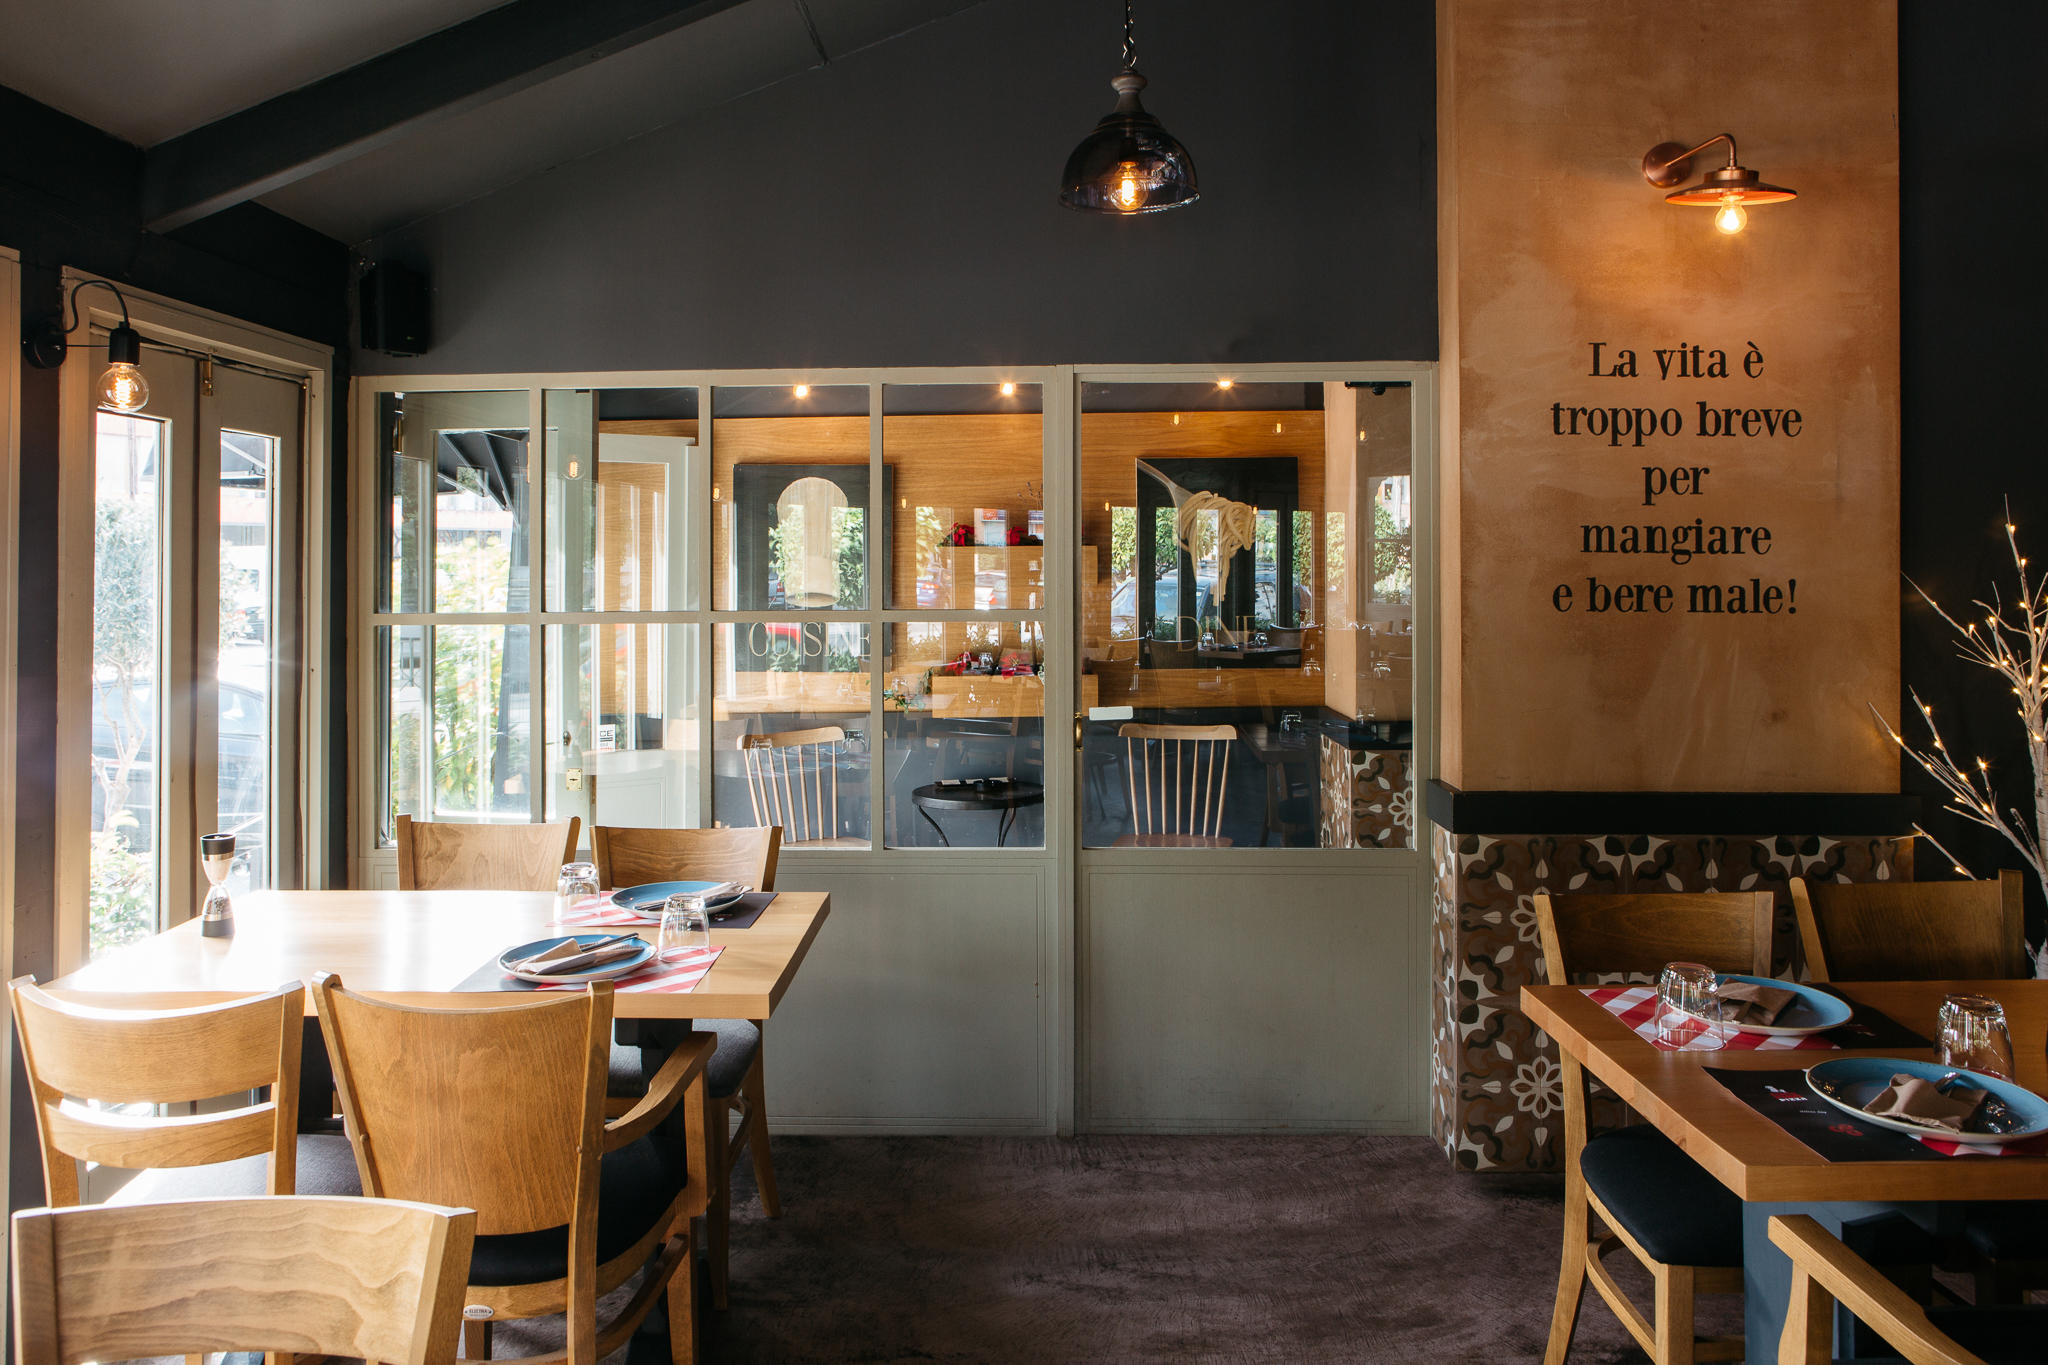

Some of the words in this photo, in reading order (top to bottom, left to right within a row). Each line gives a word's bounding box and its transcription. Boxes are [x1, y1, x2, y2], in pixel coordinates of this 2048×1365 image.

[1588, 342, 1639, 377] La
[1653, 342, 1729, 380] vita
[1743, 341, 1764, 378] è
[1550, 402, 1682, 446] troppo
[1696, 401, 1802, 437] breve
[1642, 466, 1710, 506] per
[1580, 518, 1772, 565] mangiare
[1552, 584, 1573, 612] e
[1586, 577, 1674, 613] bere
[1687, 579, 1797, 614] male!
[749, 622, 871, 657] CUISINE
[1176, 615, 1264, 652] DINE
